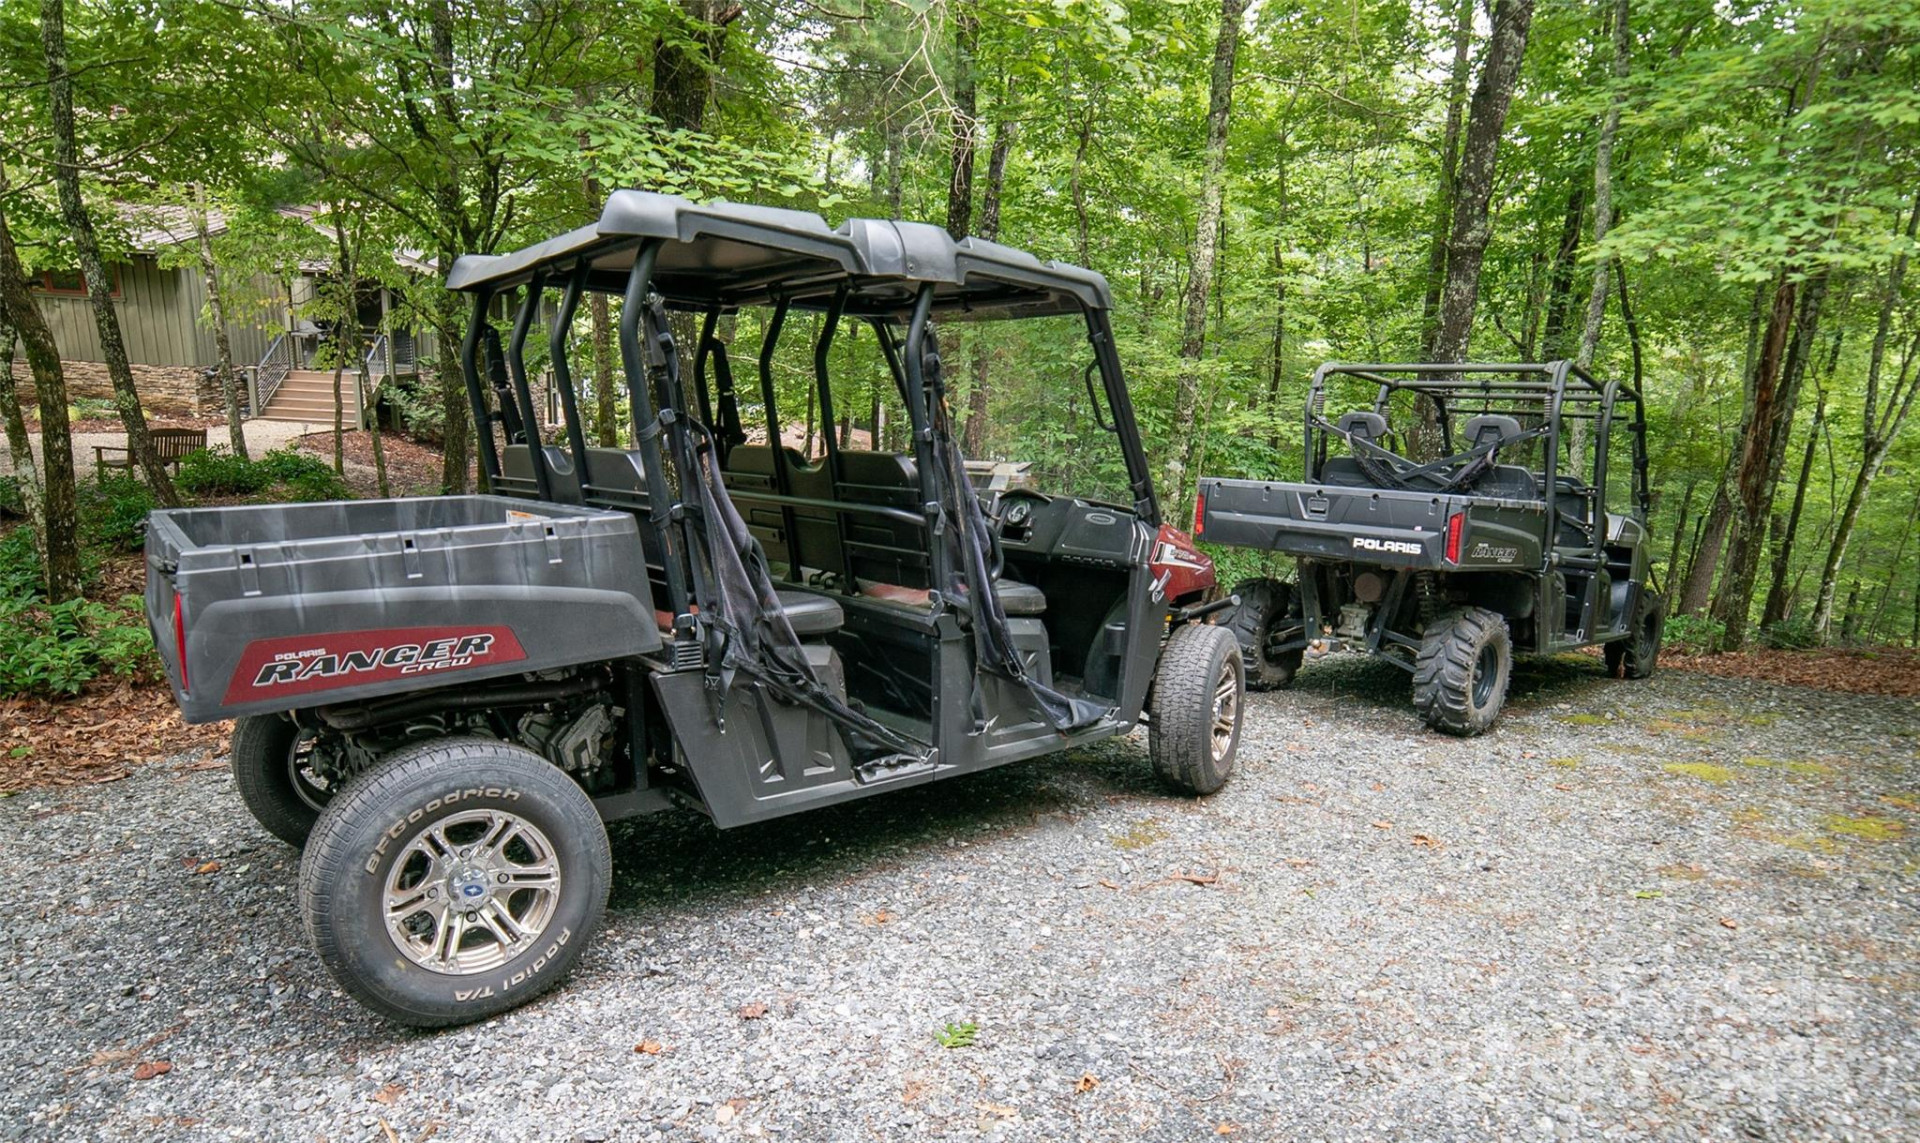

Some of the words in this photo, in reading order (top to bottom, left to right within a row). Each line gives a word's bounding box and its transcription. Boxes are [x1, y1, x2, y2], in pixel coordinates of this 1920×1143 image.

[1352, 537, 1422, 555] POLARIS
[252, 633, 495, 687] RANGER
[274, 648, 326, 662] POLARIS
[401, 656, 473, 674] CREW
[365, 785, 520, 875] BFGoodrich
[503, 926, 571, 991] Radial
[454, 985, 495, 1002] T/A
